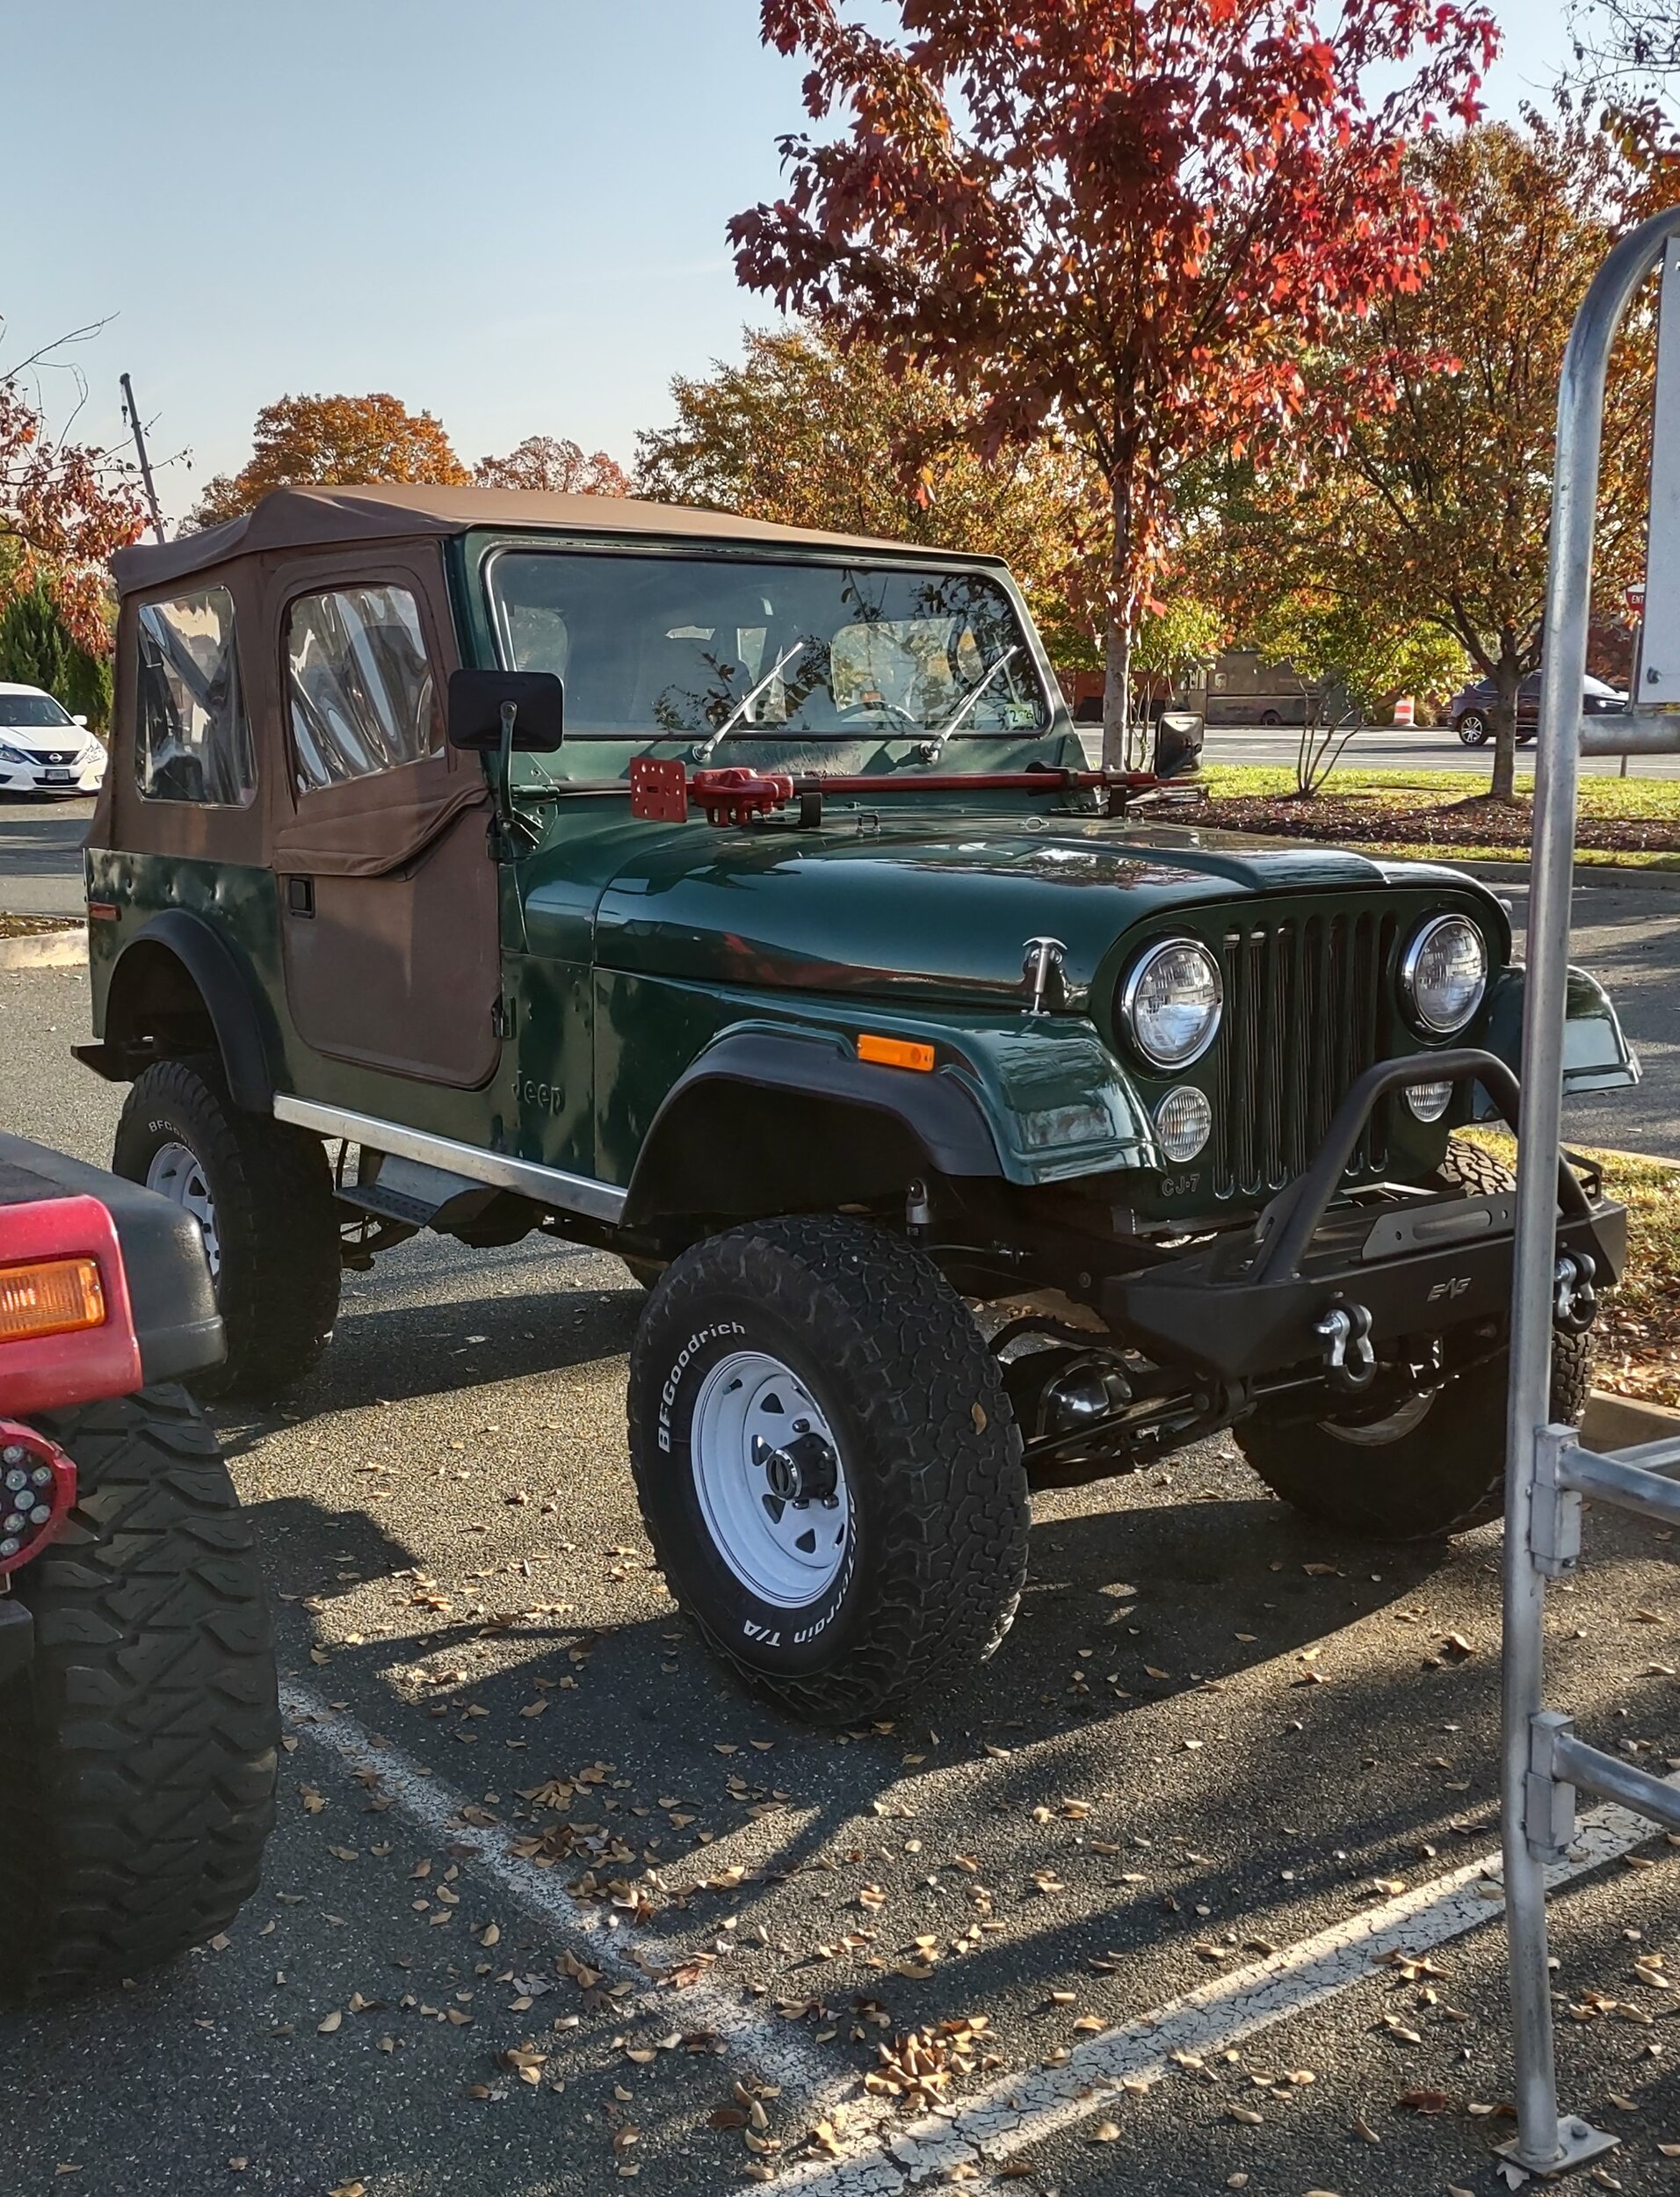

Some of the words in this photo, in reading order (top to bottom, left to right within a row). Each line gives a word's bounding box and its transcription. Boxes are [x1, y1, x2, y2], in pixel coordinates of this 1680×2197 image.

[1631, 595, 1644, 605] ENT
[511, 1069, 565, 1116] Jeep
[659, 1322, 745, 1453] BFGoodrich
[743, 1619, 780, 1647] T/A
